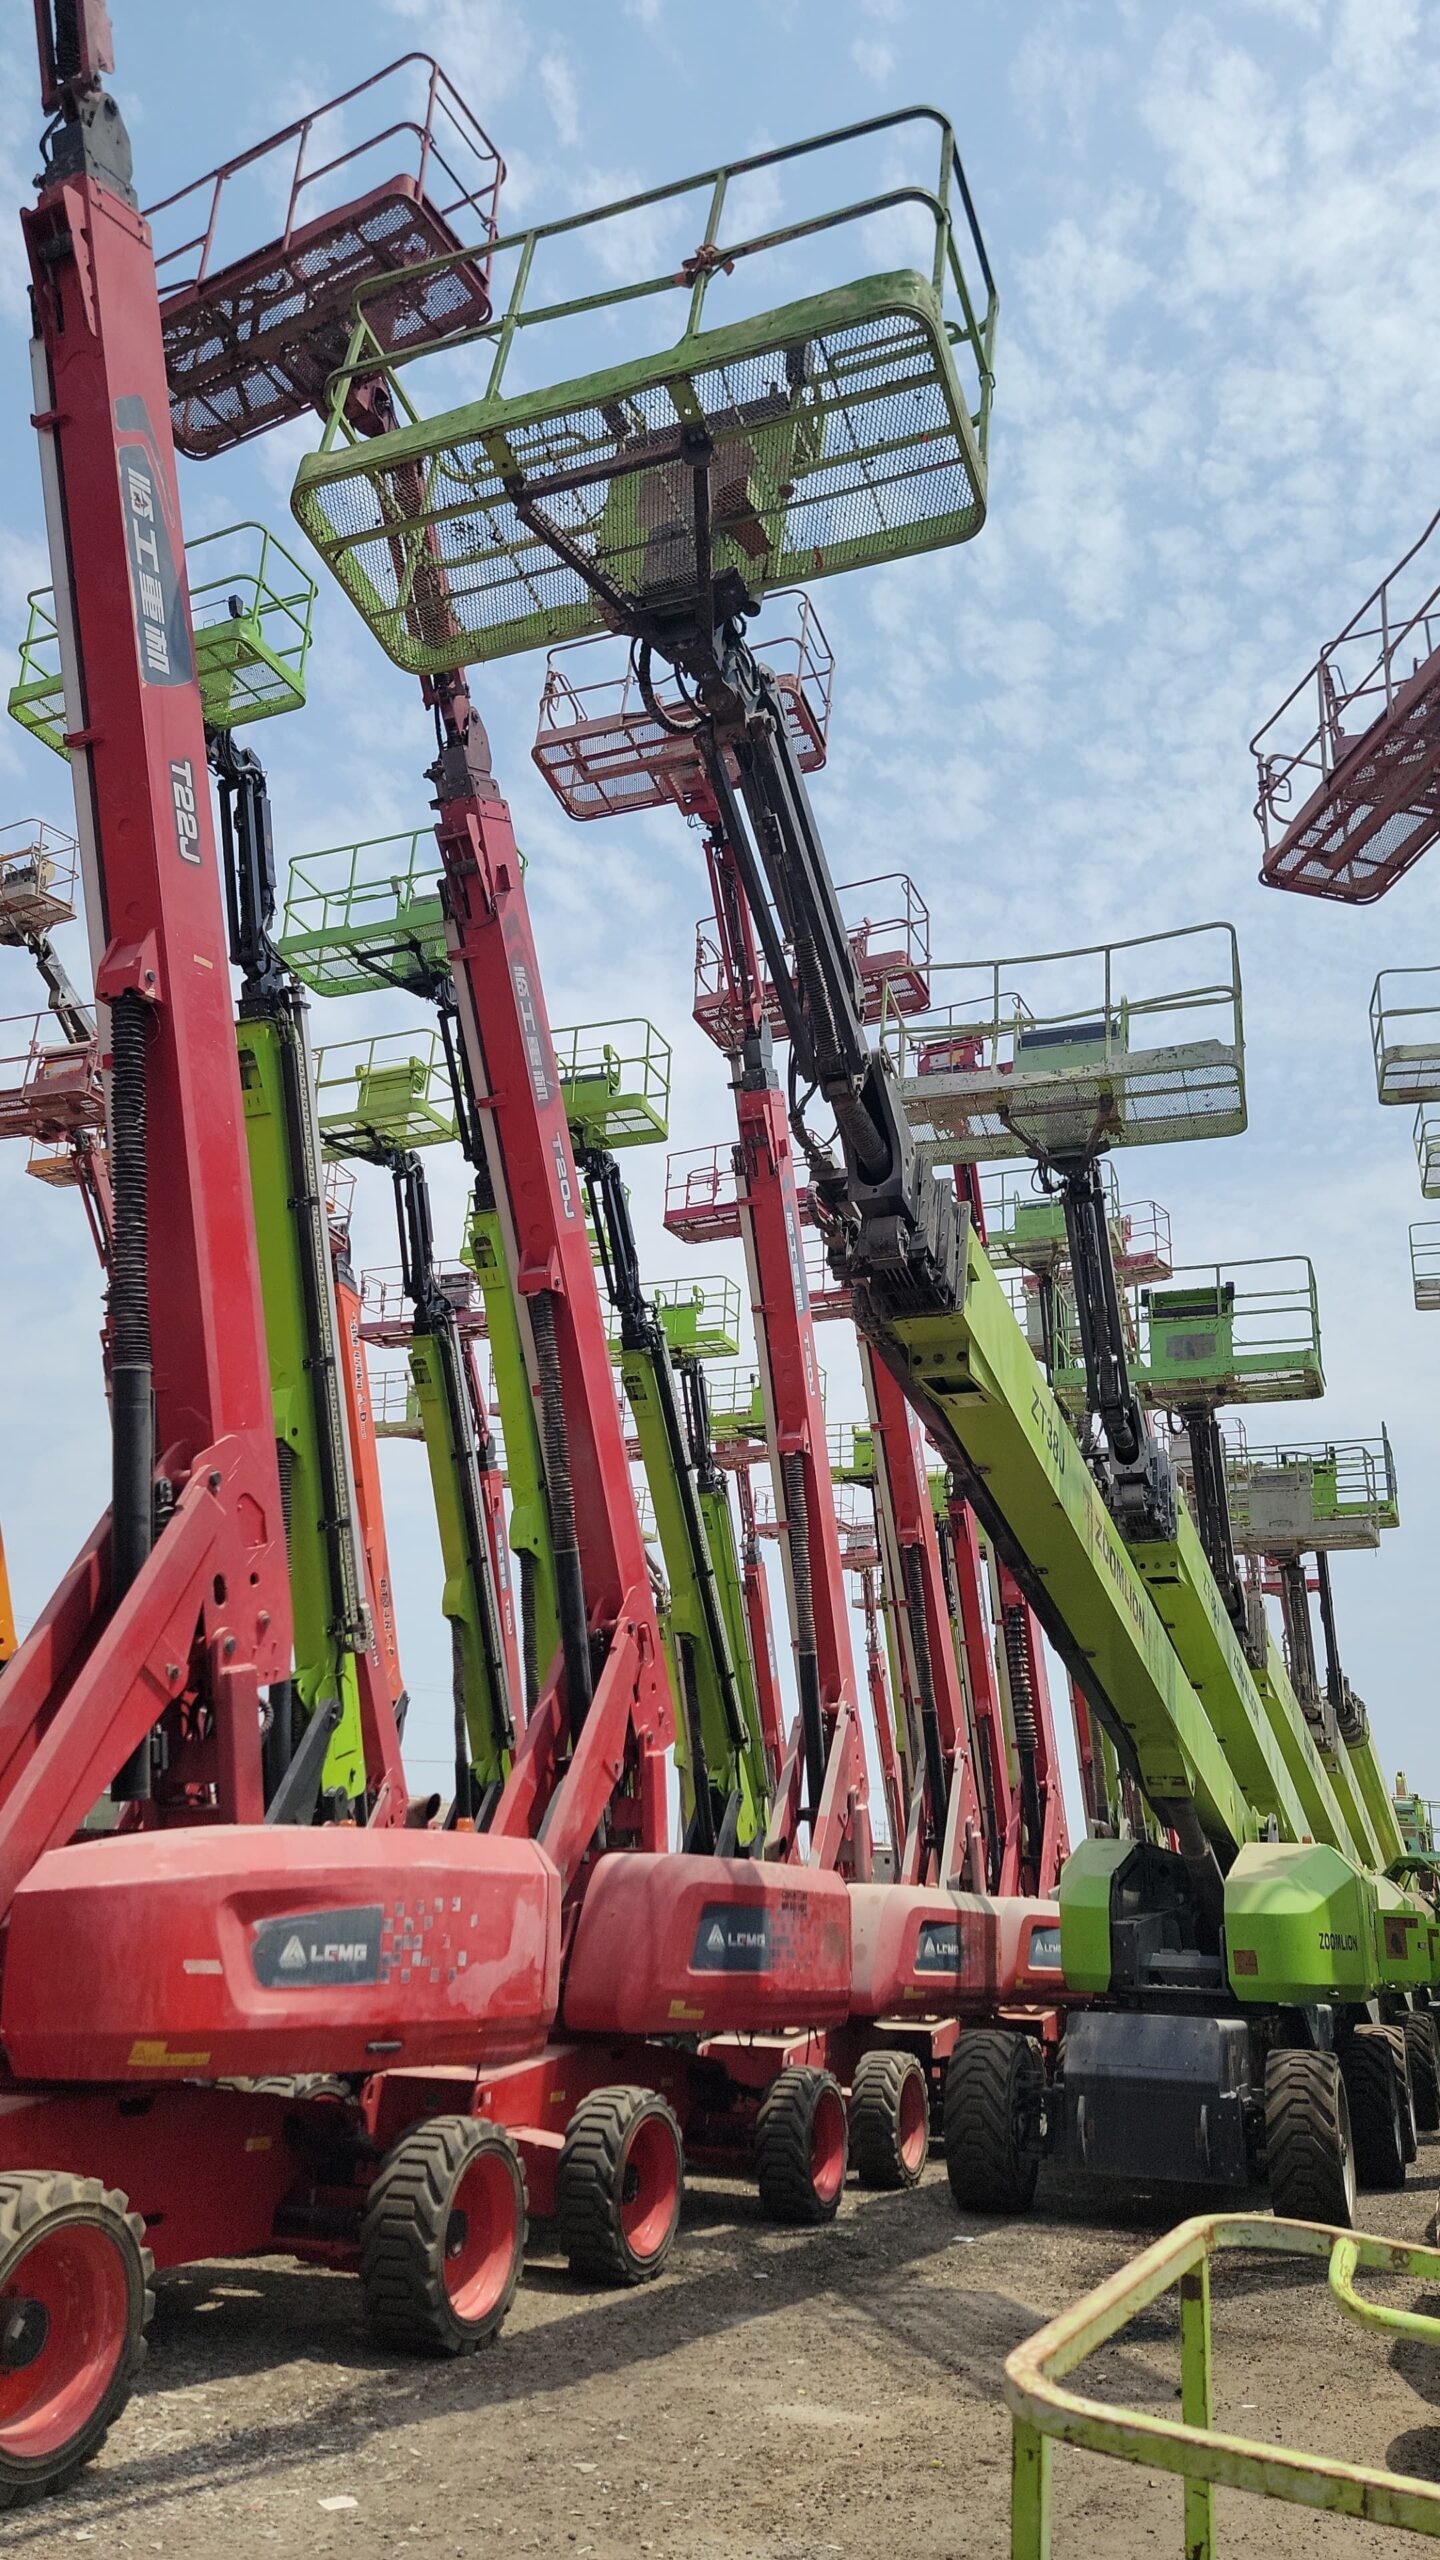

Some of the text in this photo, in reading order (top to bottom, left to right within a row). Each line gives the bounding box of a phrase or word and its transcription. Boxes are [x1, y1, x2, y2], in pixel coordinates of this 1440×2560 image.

[170, 757, 201, 866] T22J
[551, 1131, 576, 1219] T20J
[1031, 1385, 1066, 1476] ZT38J
[1095, 1518, 1146, 1635] ZOOMLION
[310, 1943, 368, 1963] LGMG
[727, 1932, 766, 1948] LGMG
[1318, 1932, 1358, 1951] ZOOMLION
